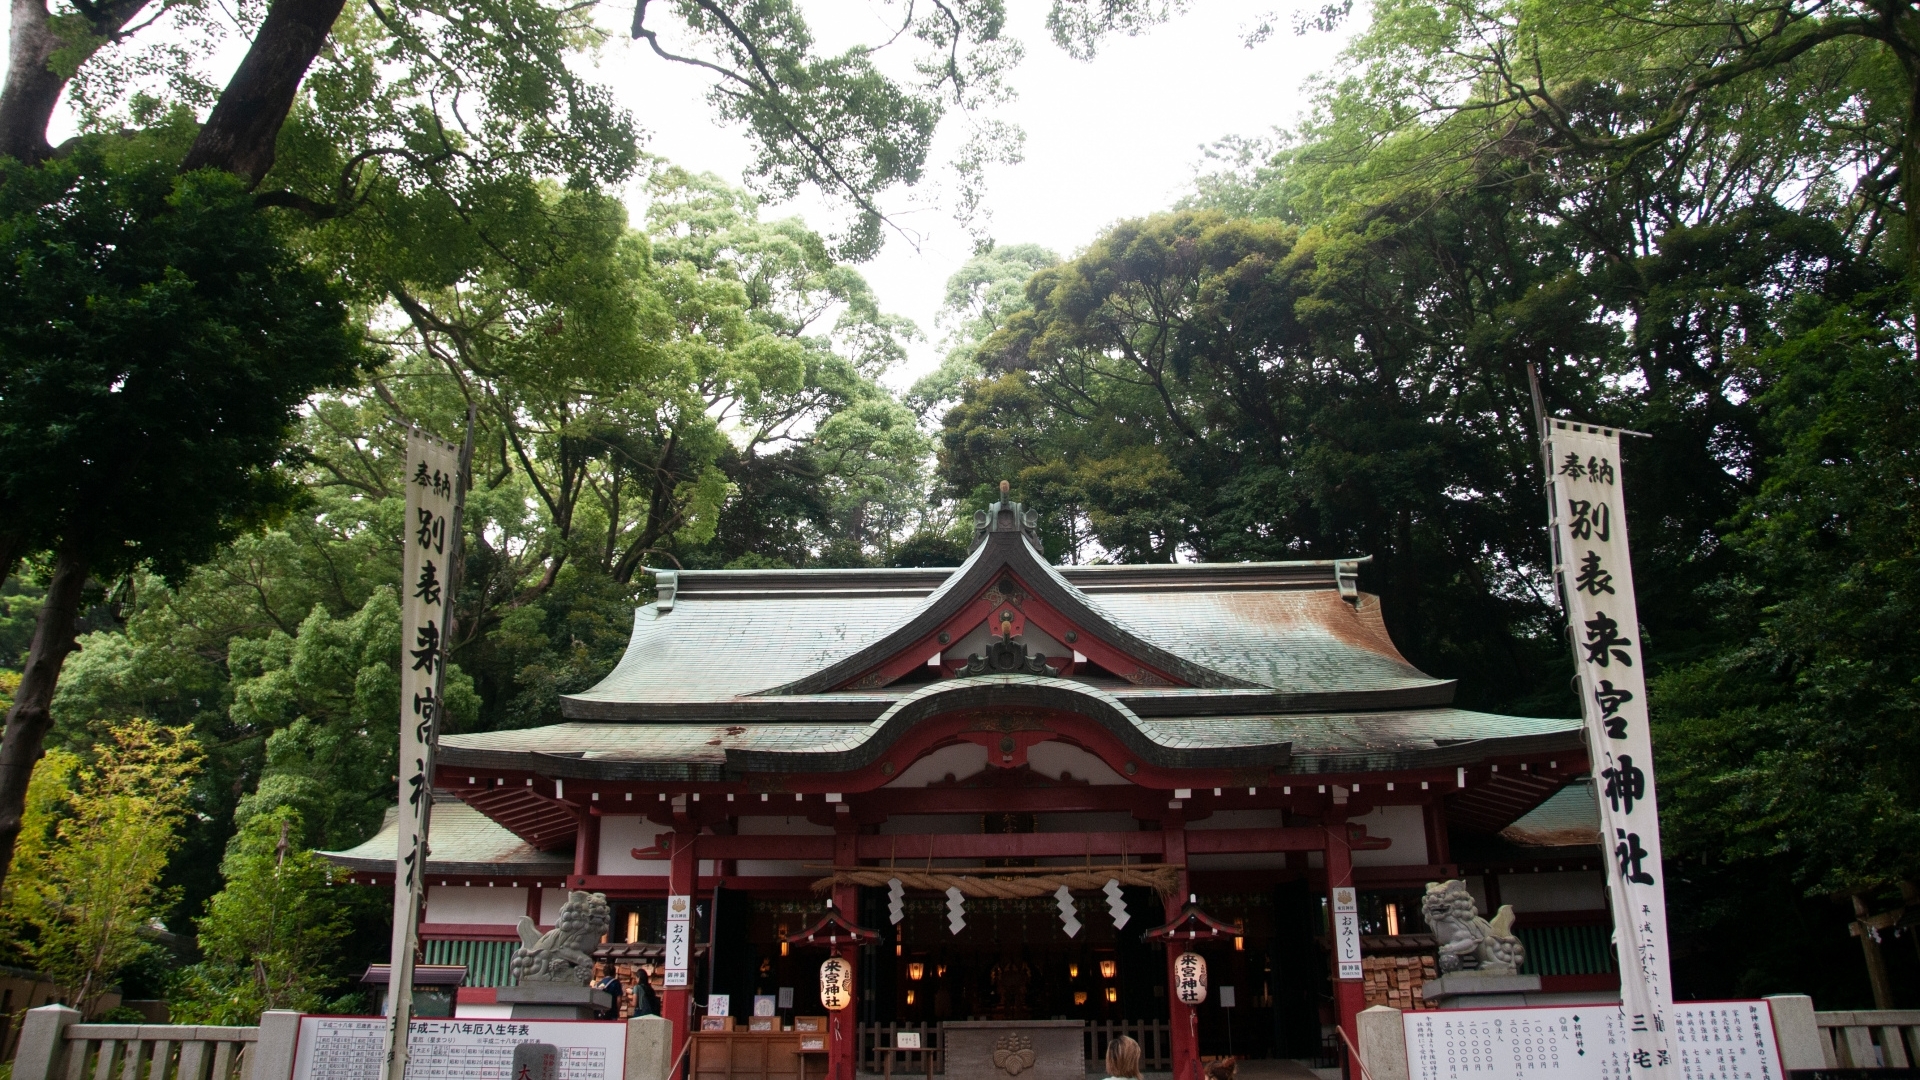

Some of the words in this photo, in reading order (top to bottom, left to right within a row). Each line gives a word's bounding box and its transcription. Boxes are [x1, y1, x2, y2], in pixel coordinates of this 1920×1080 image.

[411, 459, 451, 503] 奉納
[1558, 451, 1614, 486] 奉納
[672, 923, 684, 967] おみくじ
[1342, 915, 1355, 959] おみくじ
[409, 1022, 530, 1036] 平成二十八年厄入生年表
[1732, 1009, 1744, 1041] 家内安全
